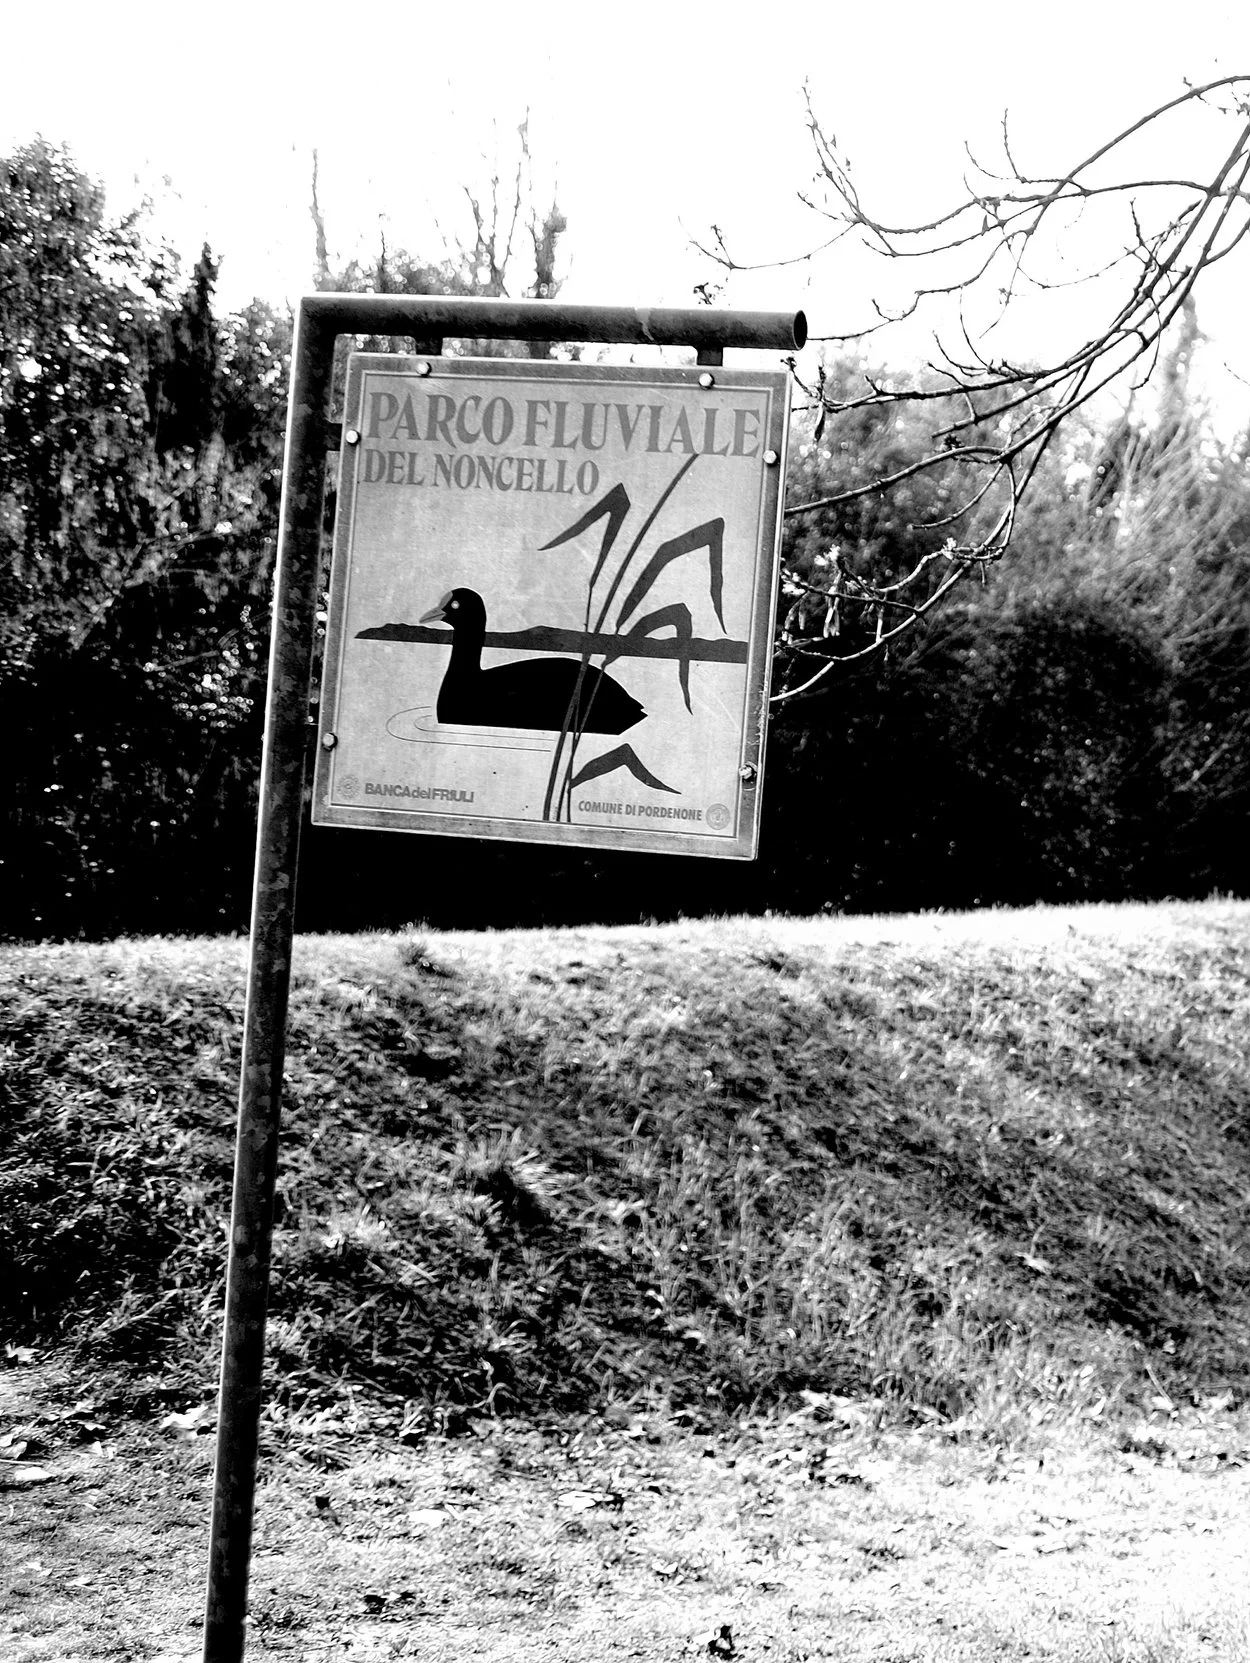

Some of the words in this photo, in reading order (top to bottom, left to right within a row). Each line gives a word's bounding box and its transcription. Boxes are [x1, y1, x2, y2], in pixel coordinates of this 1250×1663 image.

[366, 392, 514, 448] PARCO
[522, 399, 761, 458] FLUVIALE
[363, 449, 424, 485] DEL
[431, 453, 600, 495] NONCELLO
[578, 801, 623, 815] COMUNE
[625, 805, 636, 816] DI
[638, 806, 702, 821] PORDENONE
